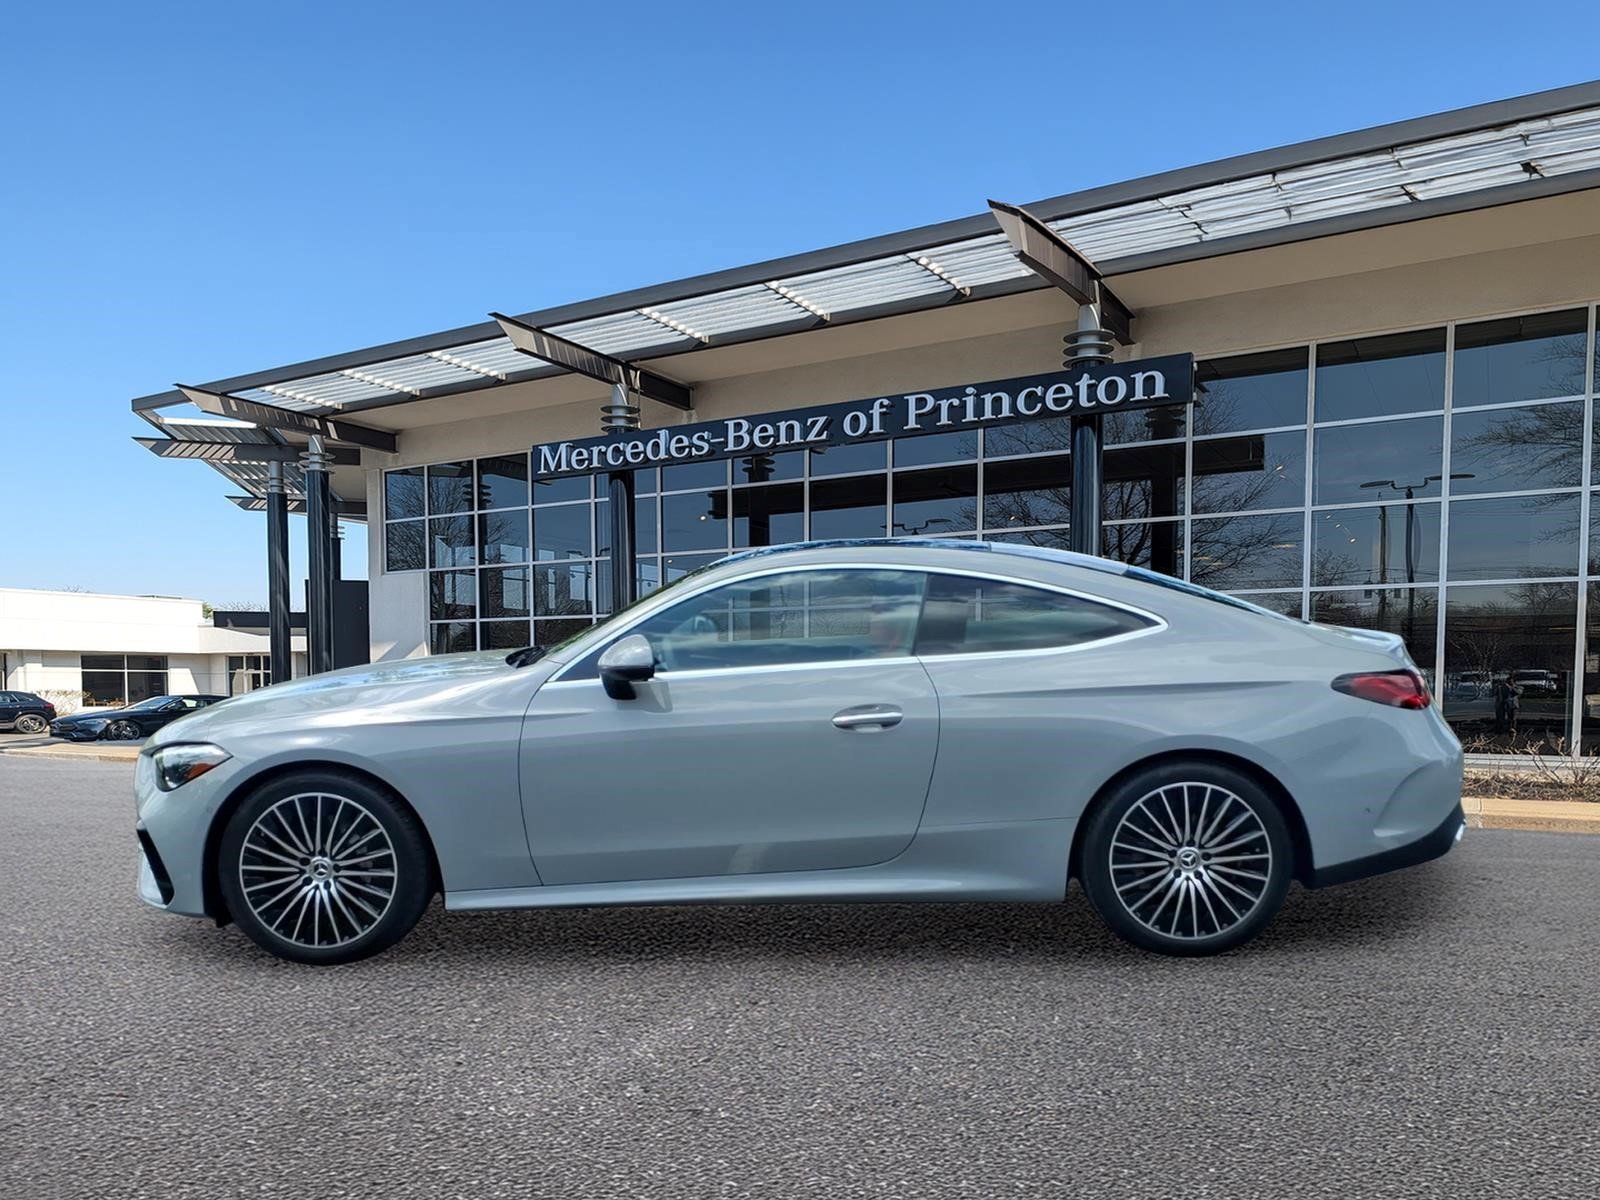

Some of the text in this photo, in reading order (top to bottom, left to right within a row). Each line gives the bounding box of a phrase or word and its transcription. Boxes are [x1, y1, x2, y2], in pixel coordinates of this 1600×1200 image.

[536, 368, 1169, 474] Mercedes-Benz of Princeton
